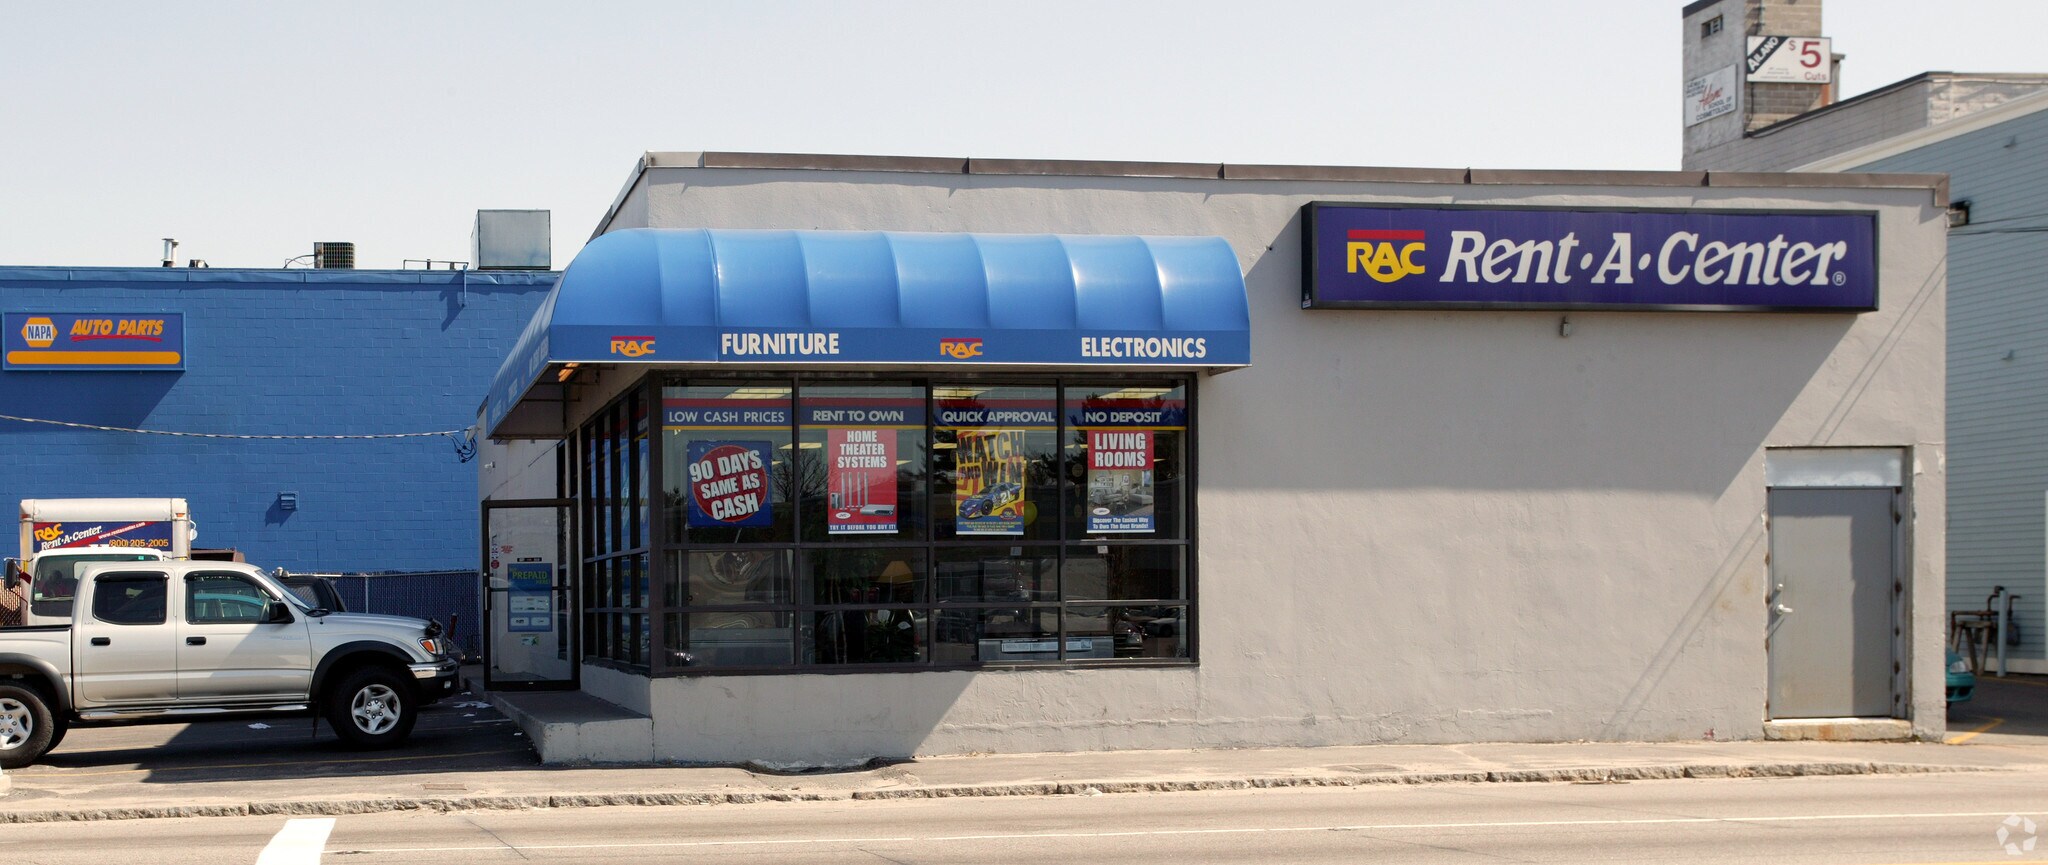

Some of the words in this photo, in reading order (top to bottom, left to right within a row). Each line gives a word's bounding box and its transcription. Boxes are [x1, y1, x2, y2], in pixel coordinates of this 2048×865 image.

[1788, 40, 1796, 51] $
[1800, 41, 1821, 69] 5
[1804, 71, 1827, 81] Cuts
[1347, 241, 1426, 283] RAC
[27, 325, 52, 340] NAPA
[70, 319, 112, 336] AUTO
[116, 319, 164, 336] PARTS
[611, 340, 656, 357] RAC
[721, 333, 840, 355] FURNITURE
[940, 342, 983, 359] RAC
[1081, 337, 1206, 358] ELECTRONICS
[668, 411, 699, 423] LOW
[704, 411, 738, 423] CASH
[743, 411, 785, 423] PRICES
[812, 410, 845, 422] RENT
[848, 410, 865, 422] TO
[868, 410, 905, 422] OWN
[942, 411, 984, 423] QUICK
[986, 411, 1055, 423] APPROVAL
[1085, 411, 1107, 423] NO
[1110, 411, 1162, 423] DEPOSIT
[847, 430, 877, 443] HOME
[1095, 432, 1146, 450] LIVING
[839, 443, 885, 456] THEATER
[957, 431, 1024, 463] WATCH
[689, 460, 714, 483] 90
[717, 450, 762, 476] DAYS
[837, 456, 887, 469] SYSTEMS
[1095, 451, 1146, 468] ROOMS
[957, 465, 981, 480] AND
[980, 460, 1023, 486] WIN
[701, 477, 739, 499] SAME
[742, 473, 760, 490] AS
[711, 493, 759, 520] CASH
[34, 523, 64, 542] RAC
[512, 571, 547, 580] PREPAID
